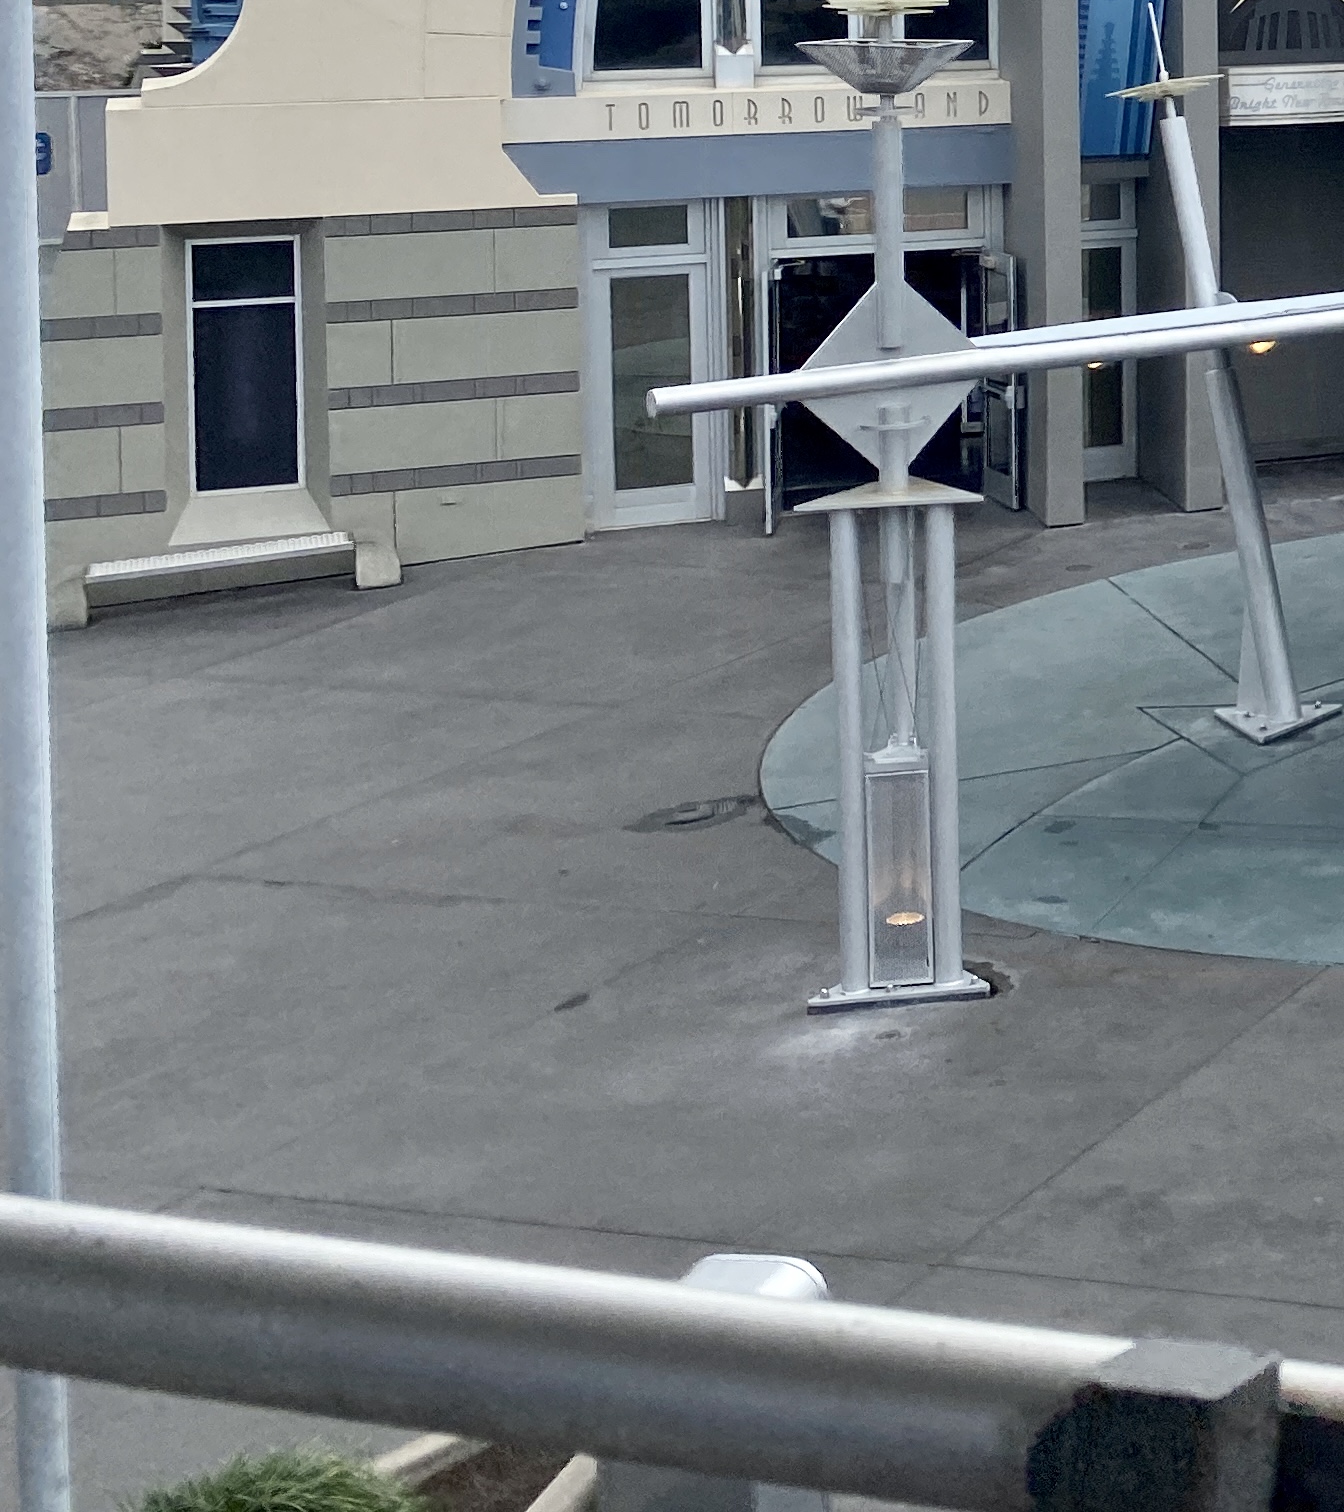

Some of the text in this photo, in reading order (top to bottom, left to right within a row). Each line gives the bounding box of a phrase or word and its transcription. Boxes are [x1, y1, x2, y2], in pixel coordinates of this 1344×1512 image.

[1263, 76, 1340, 93] Generag
[605, 90, 989, 131] TOMORROWAND
[1229, 95, 1278, 113] Bright
